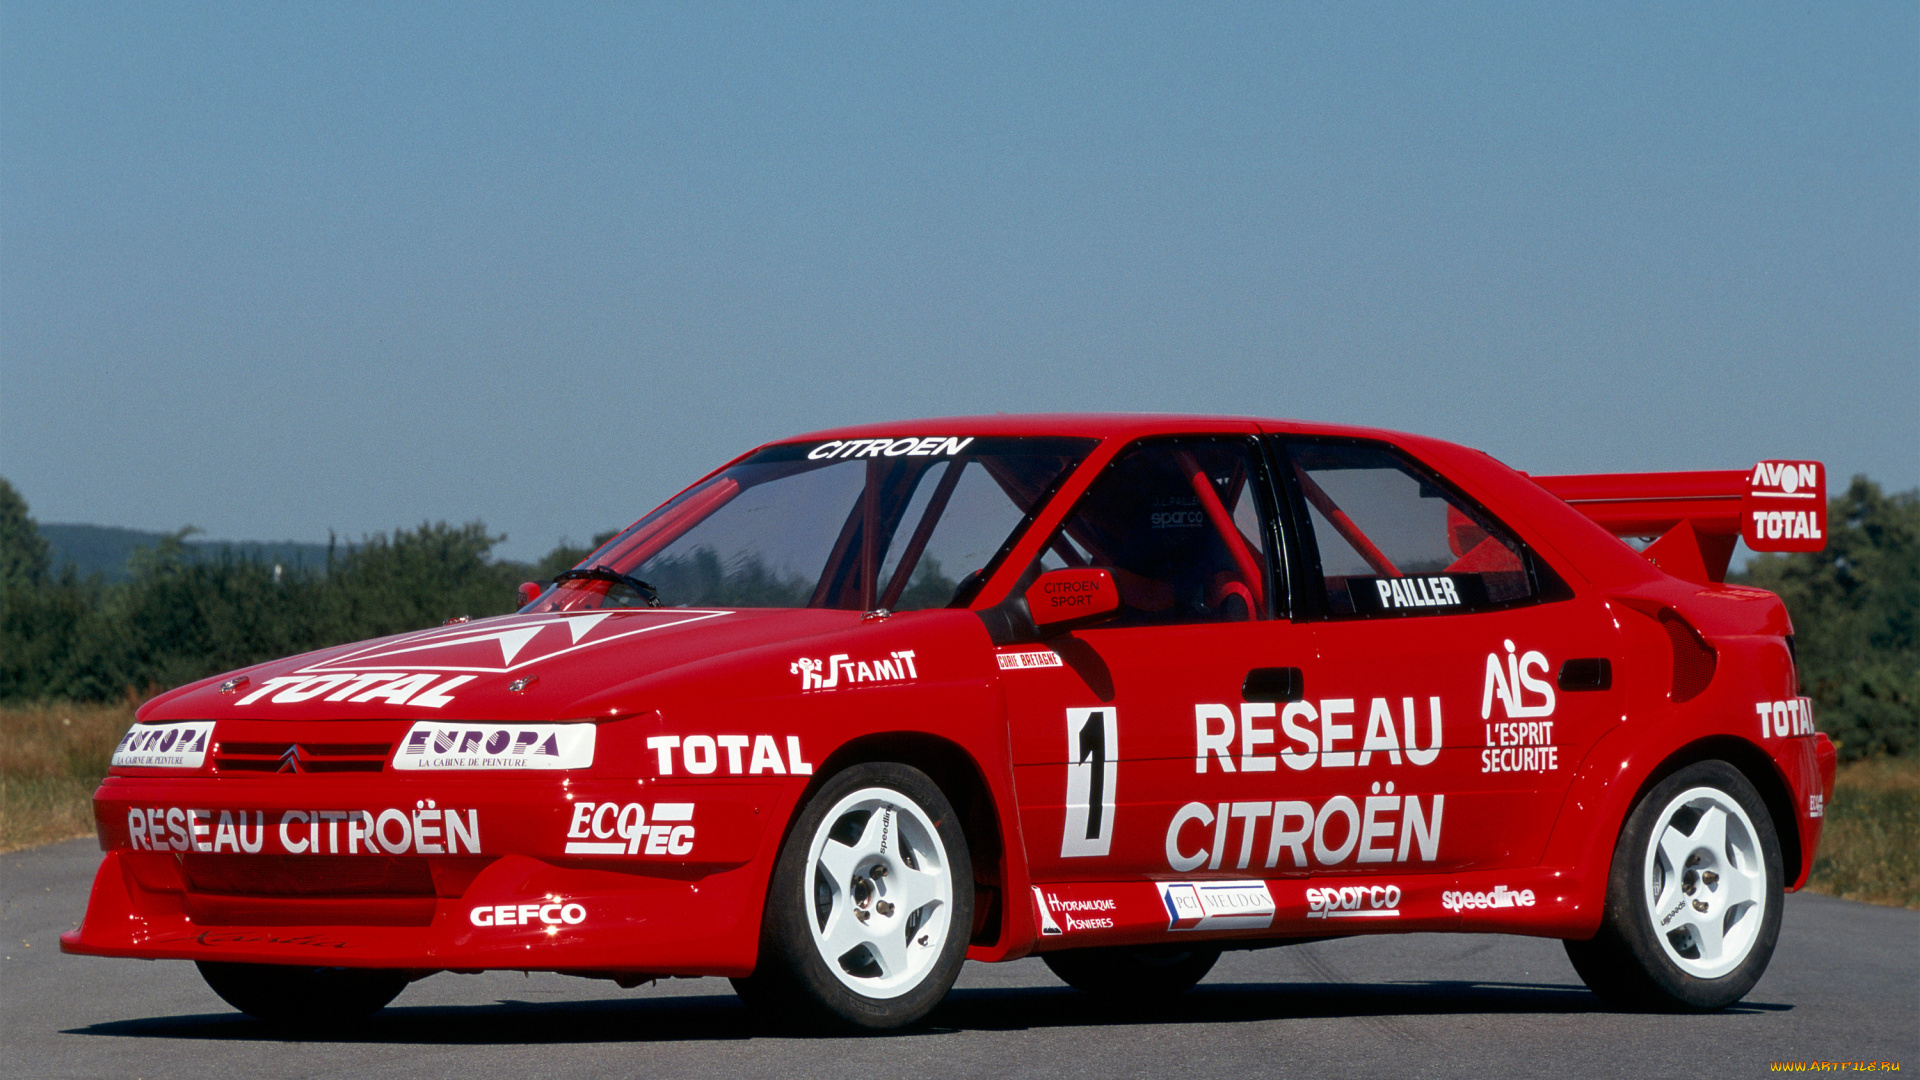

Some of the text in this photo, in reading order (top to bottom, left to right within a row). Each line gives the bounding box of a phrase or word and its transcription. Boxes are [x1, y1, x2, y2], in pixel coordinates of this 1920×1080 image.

[807, 436, 974, 460] CITROEN
[1752, 463, 1816, 493] AVON
[1753, 511, 1821, 539] TOTAL
[1044, 581, 1099, 594] CITROEN
[1051, 595, 1093, 607] SPORT
[1376, 577, 1461, 608] PAILLER
[1020, 652, 1058, 667] BRETAGNE
[234, 673, 478, 708] TOTAL
[1756, 699, 1814, 738] TOTAL
[116, 729, 207, 754] EUROPA
[406, 729, 559, 757] EUROPA
[1195, 696, 1443, 774] RESEAU
[1486, 721, 1553, 747] L'ESPRIT
[125, 756, 145, 765] CABINE
[146, 756, 154, 765] DE
[155, 756, 184, 765] PEINTURE
[418, 758, 528, 767] LA CABINE DE PEINTURE
[647, 734, 812, 775] TOTAL
[1481, 746, 1558, 773] SECURITE
[1079, 711, 1104, 840] 1
[128, 800, 481, 854] RESEAU CITROËN
[1165, 781, 1445, 872] CITROËN
[1176, 893, 1273, 909] PCI MEUDON
[1306, 885, 1401, 919] sparco
[1442, 885, 1536, 912] speedline
[470, 903, 586, 926] GEFCO
[1066, 913, 1114, 931] ASNIERES
[1660, 900, 1686, 926] speedlin
